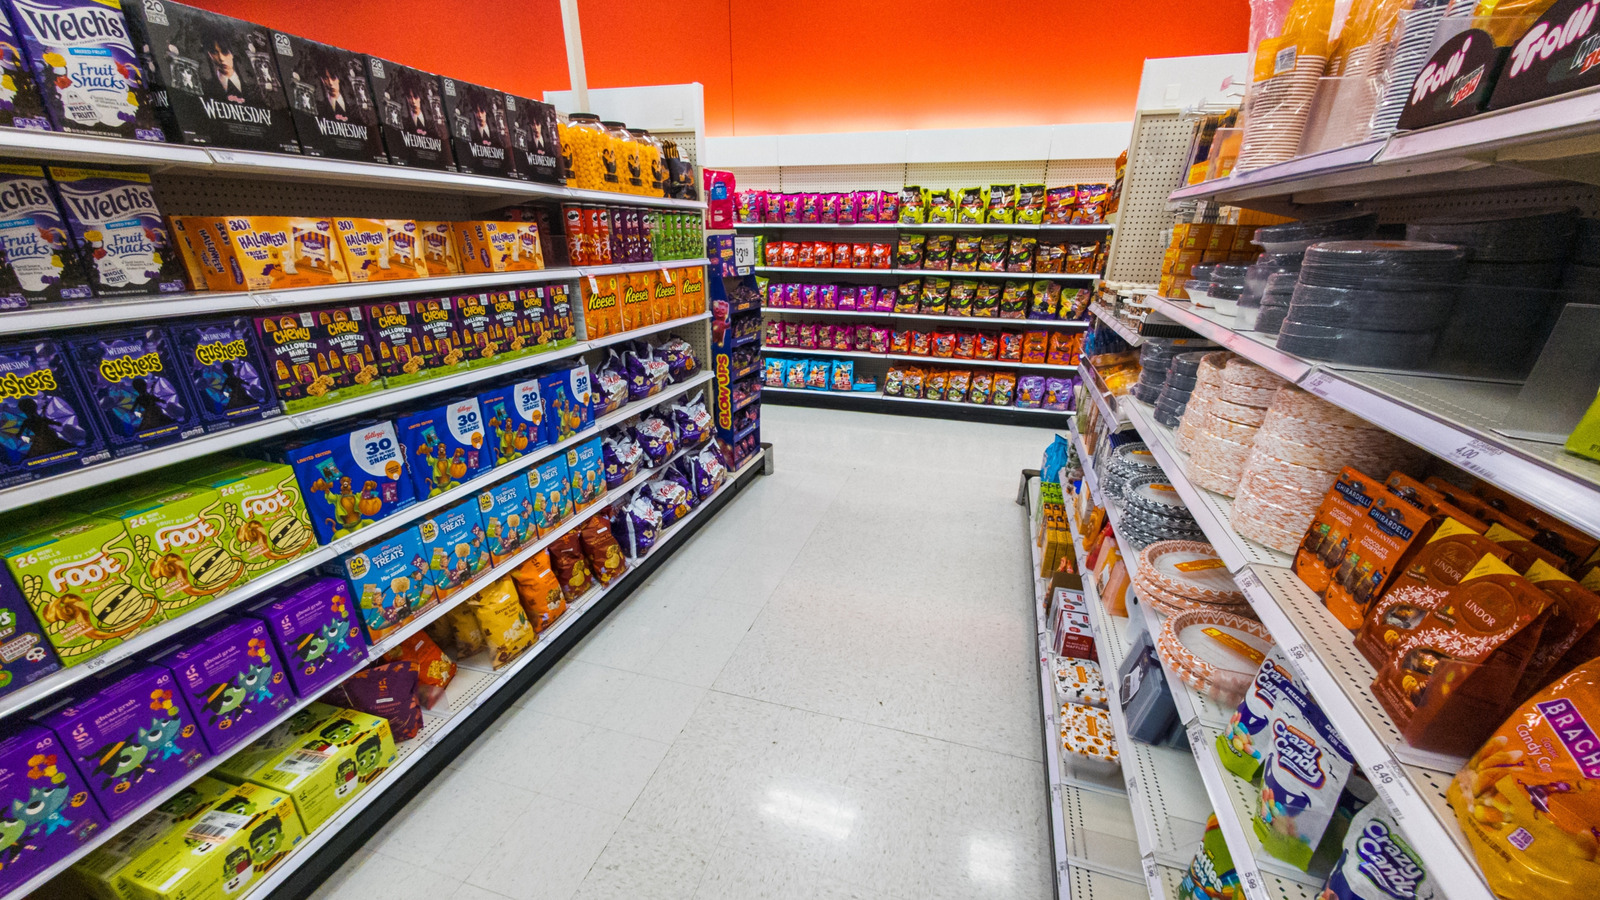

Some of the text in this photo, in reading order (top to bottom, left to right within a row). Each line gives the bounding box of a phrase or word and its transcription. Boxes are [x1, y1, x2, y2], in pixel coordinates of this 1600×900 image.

[143, 0, 165, 13] 20
[21, 7, 125, 41] Welch's
[275, 32, 291, 45] 20
[1510, 0, 1600, 78] Trolli
[78, 62, 115, 78] Fruit
[371, 58, 384, 71] 20
[1411, 35, 1472, 106] Trolli
[71, 72, 126, 91] Snacks
[67, 104, 94, 113] WHOLE
[71, 111, 97, 120] FRUIT!
[199, 96, 272, 127] WEDNESDAY
[315, 116, 368, 141] WEDNESDAY
[401, 130, 442, 151] WEDNESDAY
[469, 142, 505, 160] WEDNESDAY
[526, 152, 556, 168] WEDNESDAY
[0, 182, 48, 213] lch's
[67, 188, 153, 219] Welch's
[228, 219, 247, 231] 30
[338, 219, 351, 231] 30
[0, 233, 37, 250] Fruit
[112, 231, 144, 247] Fruit
[237, 231, 288, 250] HALLOWEEN
[344, 232, 384, 247] HALLOWEEN
[491, 232, 516, 243] HALLOWEEN
[106, 243, 155, 259] Snacks
[199, 228, 225, 273] HALLOWEEN
[102, 269, 124, 278] WHOLE
[105, 275, 127, 285] FRUIT!
[654, 282, 677, 299] Reese's
[682, 279, 703, 294] Reese's
[588, 292, 617, 311] Reese's
[625, 286, 649, 304] Reese's
[379, 326, 412, 338] HALLOWEEN
[423, 321, 453, 331] HALLOWEEN
[201, 331, 231, 342] WEDNESDAY
[328, 334, 364, 346] HALLOWEEN
[106, 344, 142, 356] WEDNESDAY
[196, 339, 248, 366] Gushers
[274, 342, 317, 356] HALLOWEEN
[100, 352, 162, 383] Gushers
[576, 376, 588, 387] 30
[522, 391, 538, 404] 30
[457, 411, 477, 426] 30
[365, 437, 392, 456] 30
[1456, 446, 1480, 459] 4.00
[369, 451, 396, 465] SNACKS
[221, 487, 236, 497] 26
[1336, 482, 1372, 506] GHIRARDELLI
[130, 517, 147, 529] 26
[156, 518, 175, 528] FRUIT
[182, 512, 195, 521] THE
[422, 523, 434, 533] 60
[441, 517, 467, 534] TREATS
[1370, 508, 1411, 539] GHIRARDELLI
[1360, 539, 1387, 560] ASSORTMENT
[1364, 535, 1388, 556] CHOCOLATE
[15, 553, 38, 569] 26
[39, 551, 61, 561] ROLLS
[50, 555, 75, 566] FRUIT
[85, 547, 98, 557] THE
[350, 557, 364, 569] 60
[374, 549, 405, 569] TREATS
[352, 565, 366, 577] Mini
[1434, 558, 1462, 581] LINDOR
[336, 584, 345, 592] 40
[1465, 598, 1496, 627] LINDOR
[253, 626, 263, 635] 40
[1290, 646, 1305, 660] 5.99
[1262, 660, 1288, 681] Craz
[156, 674, 169, 685] 40
[1257, 673, 1279, 698] Can
[1285, 686, 1308, 708] FREEZE
[95, 699, 136, 726] ghoul grub
[36, 737, 53, 749] 40
[1274, 720, 1320, 760] Crazy
[1516, 724, 1542, 756] Candy
[1275, 737, 1322, 784] Candy
[1372, 763, 1394, 785] 8.49
[1365, 820, 1423, 880] Crazy
[1196, 842, 1223, 893] ttles
[1358, 837, 1416, 898] Candy
[1245, 871, 1257, 889] 5.99
